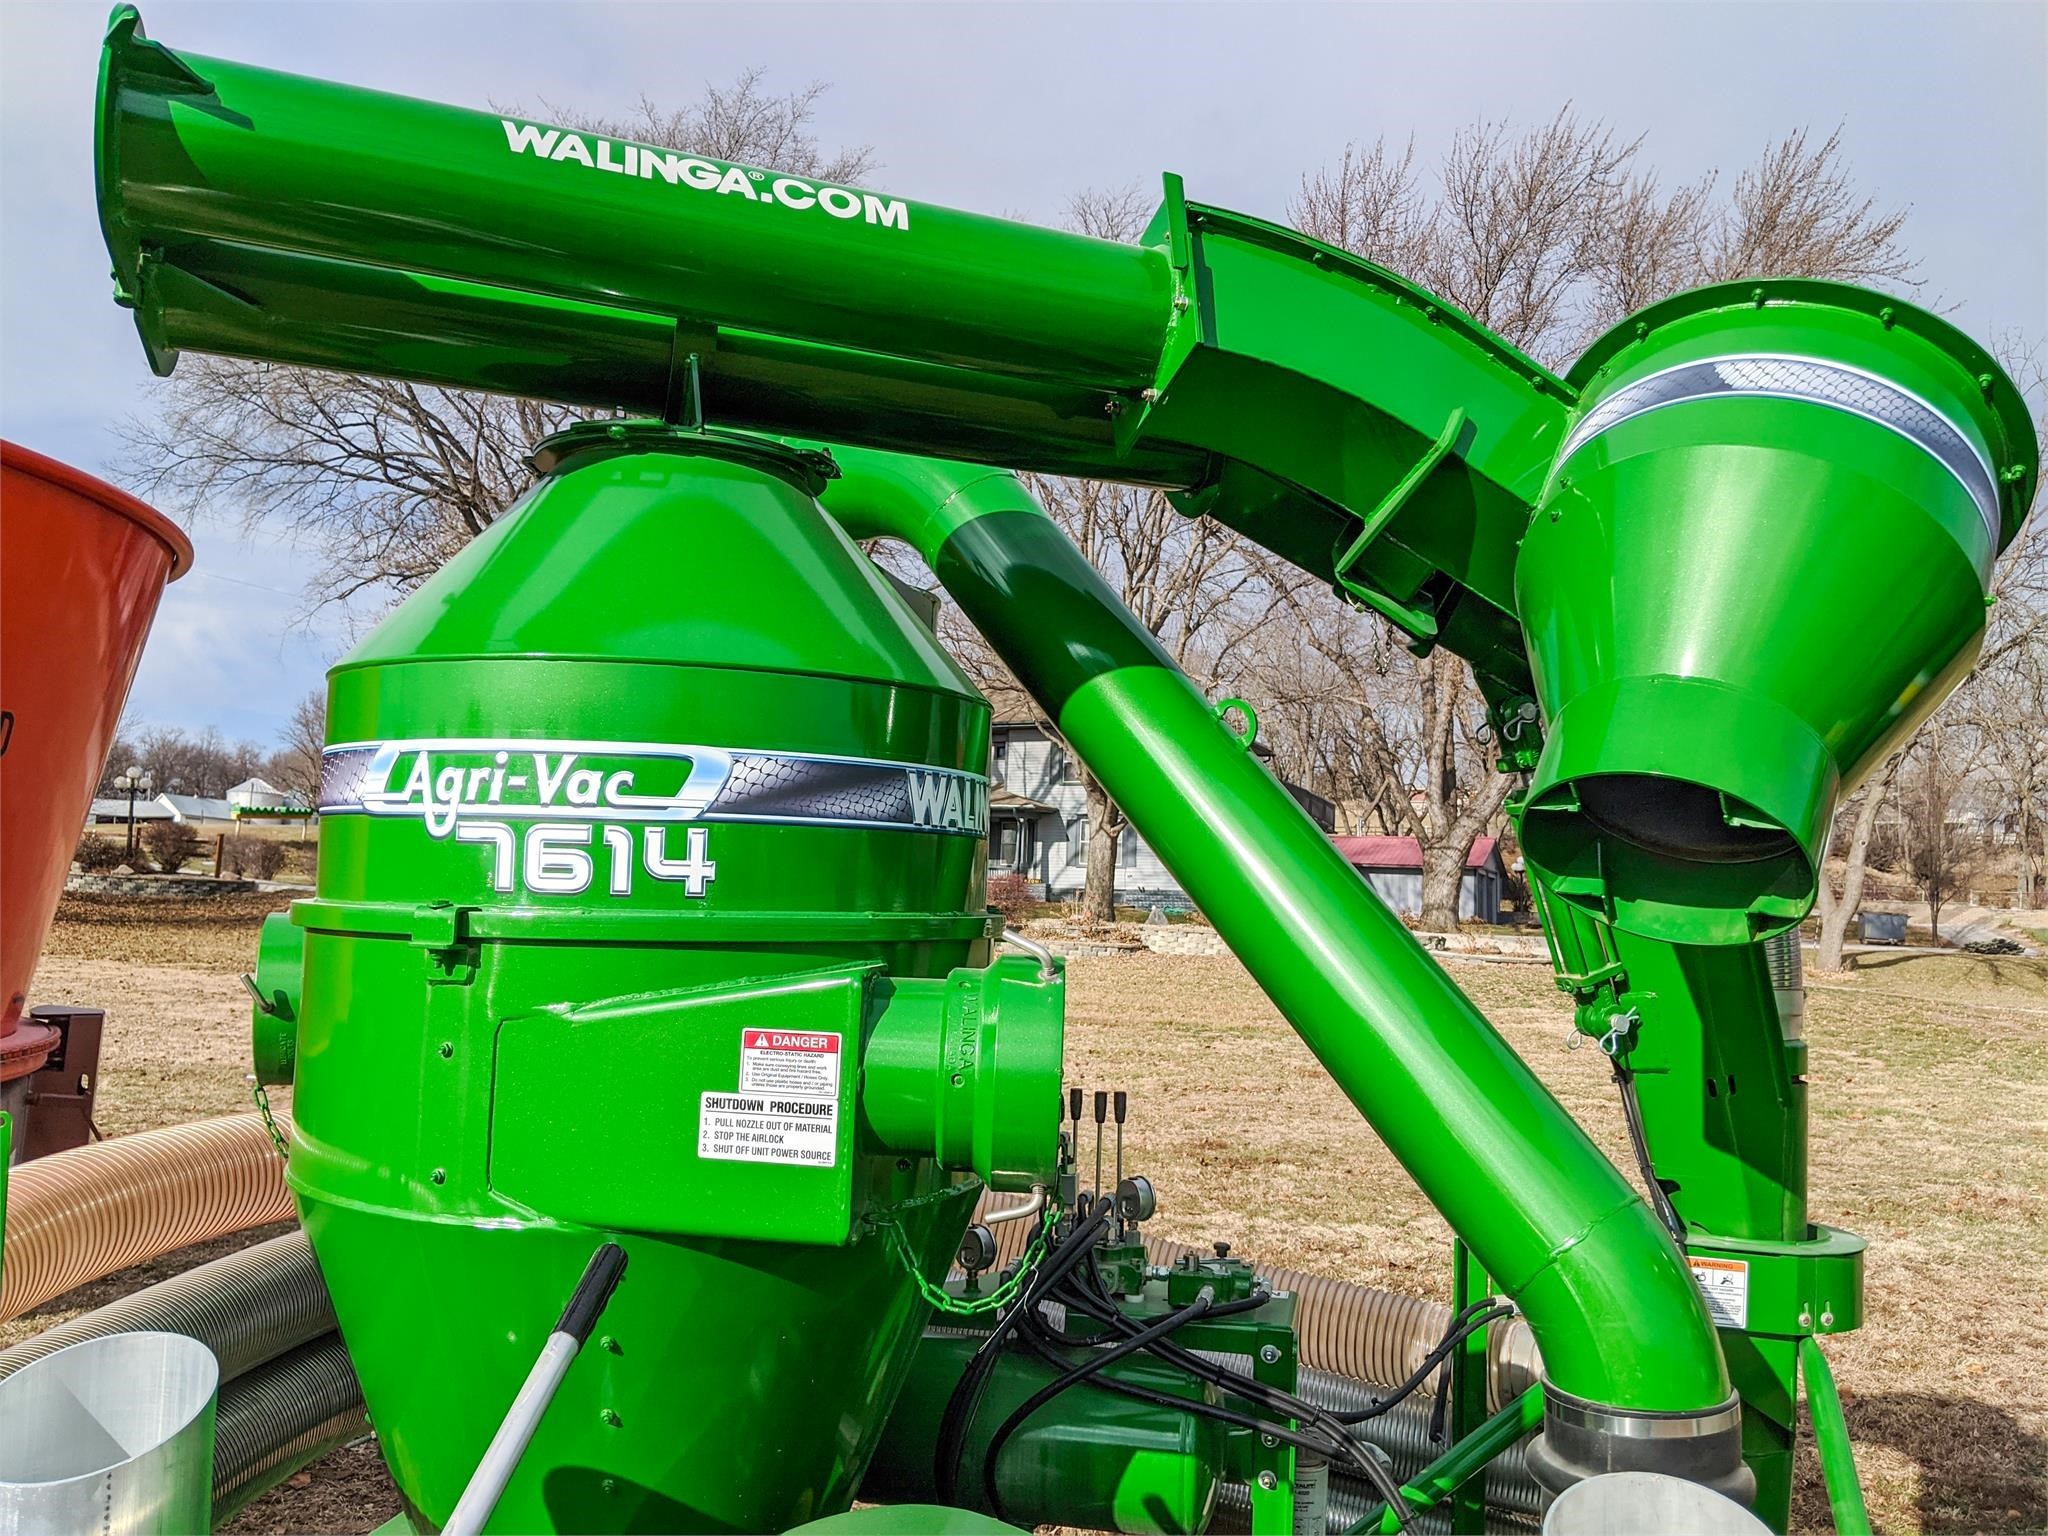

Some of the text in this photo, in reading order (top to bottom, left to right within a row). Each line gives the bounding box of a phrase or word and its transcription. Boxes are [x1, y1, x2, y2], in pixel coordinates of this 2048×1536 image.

[404, 750, 637, 838] Agri-Vac
[455, 822, 716, 897] 7614
[772, 1035, 828, 1049] DANGER
[760, 1050, 802, 1058] ELECTRO-STATIC
[705, 1096, 833, 1116] SHUTDOWN PROCEDURE
[704, 1116, 832, 1134] 1. PULL NOZZLE OUT OF MATERIAL
[702, 1130, 784, 1144] 2. STOP THE AIRLOCK
[702, 1143, 832, 1161] 3. SHUT OFF UNIT POWER SOURCE
[1700, 1261, 1734, 1270] WARNING
